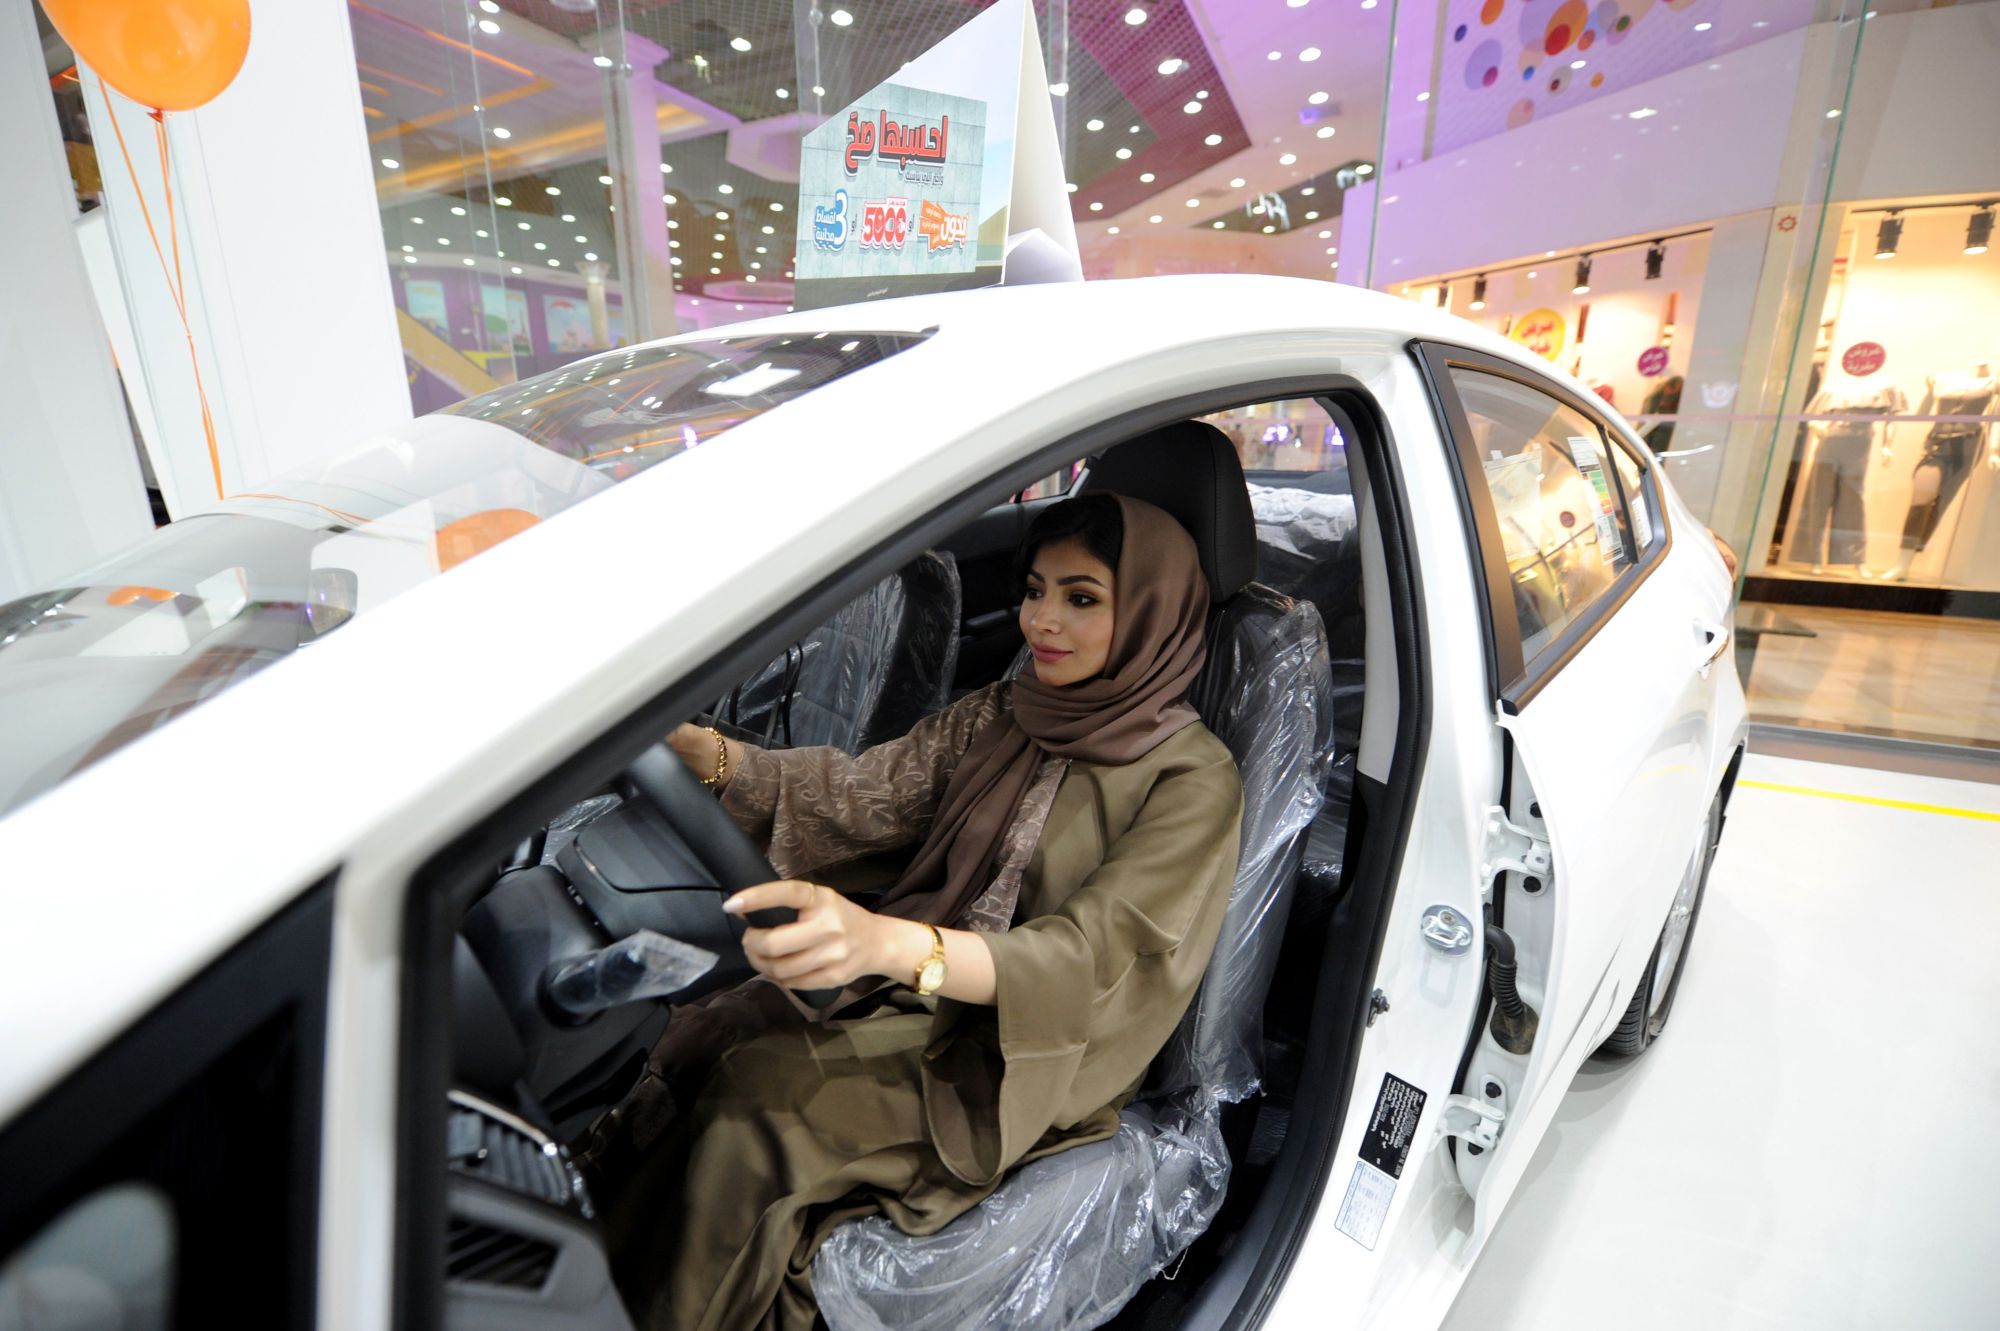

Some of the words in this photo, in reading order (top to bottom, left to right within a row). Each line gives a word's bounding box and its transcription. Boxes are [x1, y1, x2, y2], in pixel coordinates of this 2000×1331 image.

[879, 110, 948, 168] احسبها
[834, 191, 847, 245] 3
[863, 206, 907, 243] 5000
